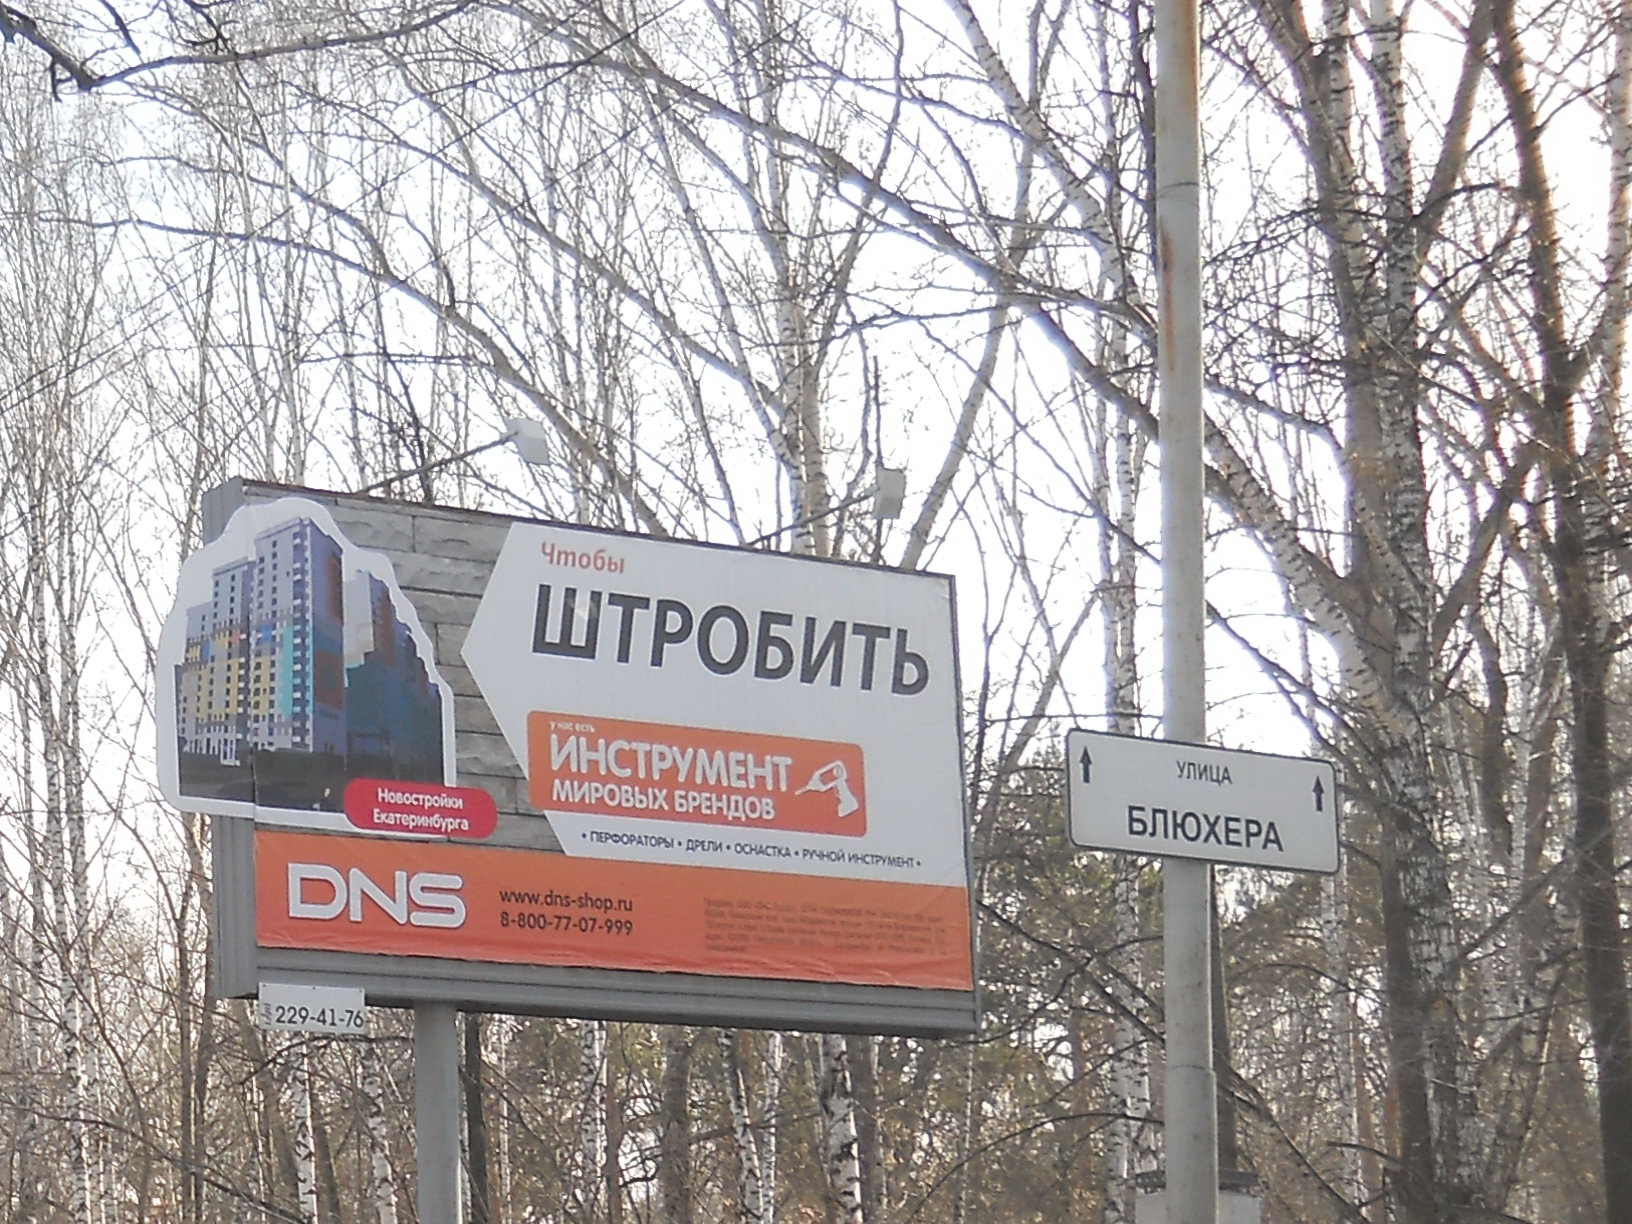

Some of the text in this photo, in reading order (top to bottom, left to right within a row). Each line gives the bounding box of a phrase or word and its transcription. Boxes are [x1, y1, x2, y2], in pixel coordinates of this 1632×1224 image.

[540, 540, 625, 574] Чтобы
[531, 583, 930, 696] ШТРОБИТЬ
[575, 722, 596, 734] есть
[549, 733, 793, 792] ИНСТРУМЕНТ
[1175, 760, 1233, 787] УЛИЦА
[377, 787, 464, 810] Новостройки
[552, 778, 776, 821] МИРОВЫХ БРЕНДОВ
[373, 808, 469, 832] Екатеринбурга
[1127, 804, 1284, 852] БЛЮХЕРА
[590, 830, 915, 869] ПЕРФОРАТОРЫ ДРЕЛИ ОСНАСТКА РУЧНОЙ ИНСТРУМЕНТ
[287, 862, 467, 929] DNS
[499, 888, 633, 915] www.dns-shop.ru
[500, 911, 633, 936] 8-800-77-07-999
[275, 1005, 364, 1029] 229-41-76
